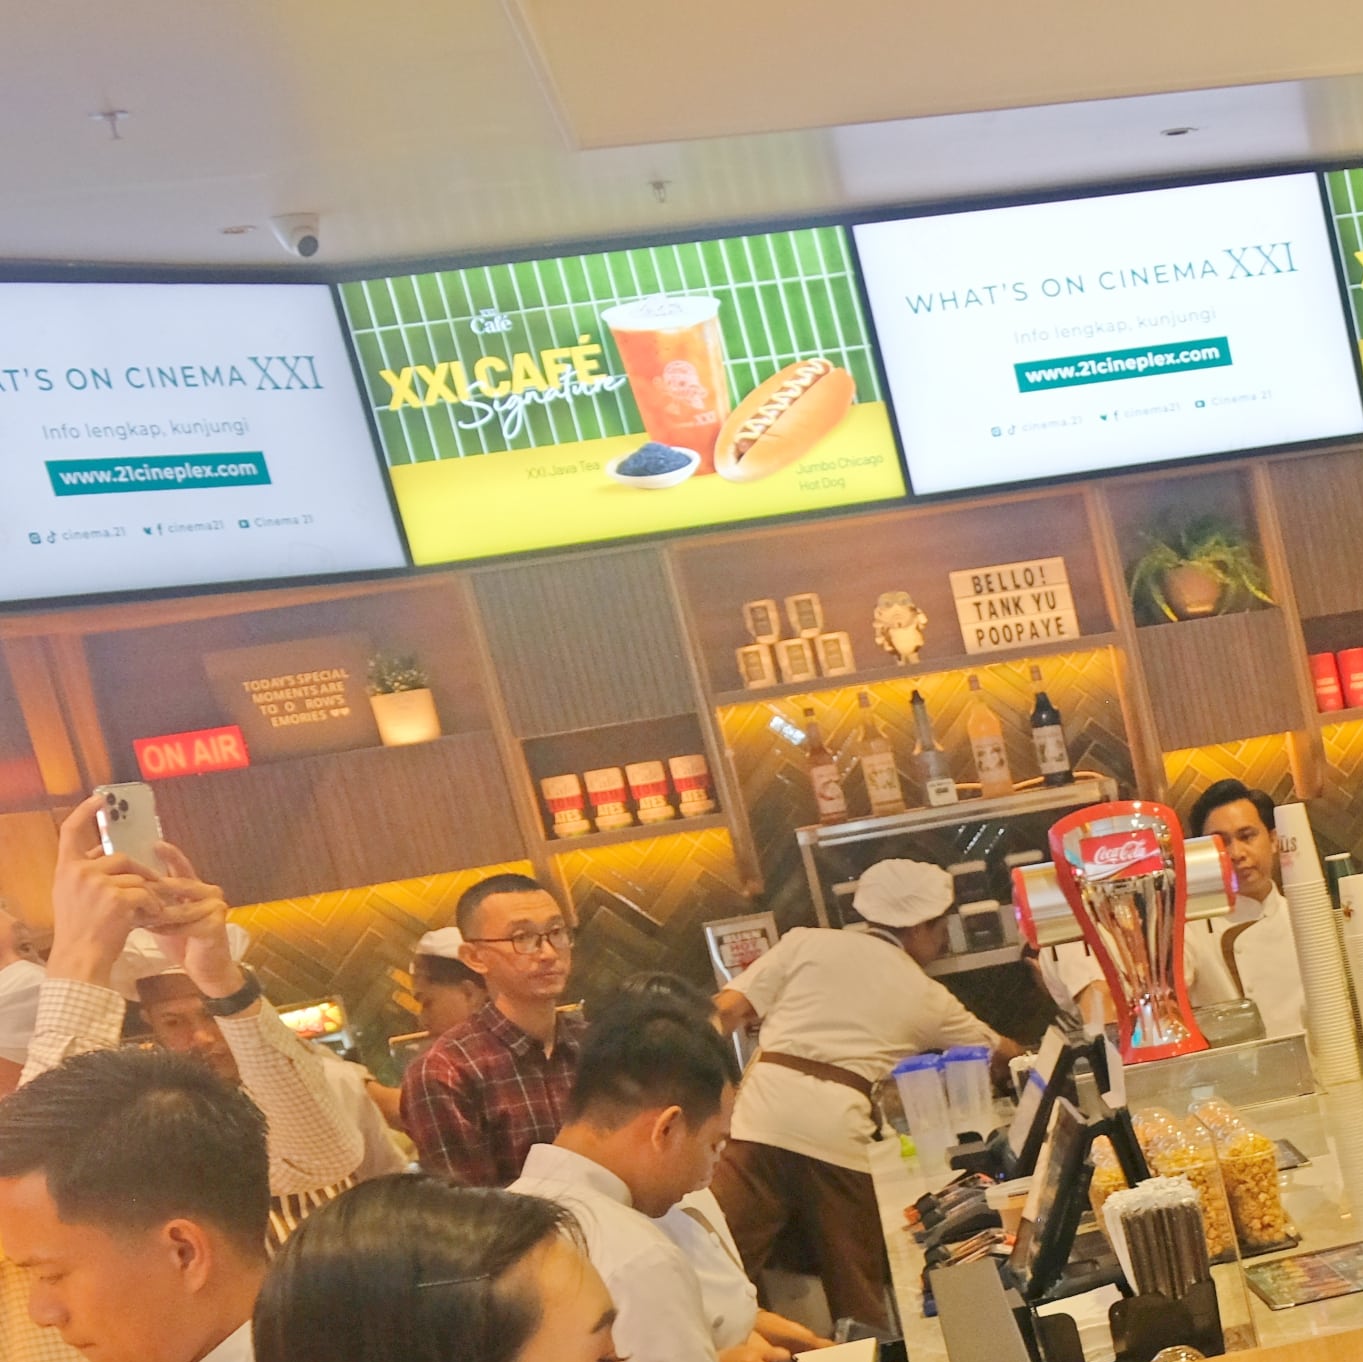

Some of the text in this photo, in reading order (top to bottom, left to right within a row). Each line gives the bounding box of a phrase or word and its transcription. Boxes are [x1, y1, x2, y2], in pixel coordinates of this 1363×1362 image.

[905, 241, 1300, 315] WHAT'S ON CINEMA XXI
[470, 314, 513, 335] Café
[1013, 327, 1051, 345] Info
[1137, 307, 1217, 333] kunjungi
[65, 367, 112, 391] ON
[125, 364, 247, 389] CINEMA
[248, 355, 324, 390] XXI
[379, 334, 607, 411] XXI CAFÉ
[1025, 344, 1220, 385] www.21cineplex.com
[458, 364, 626, 440] Signature
[42, 417, 249, 442] Info lengkap, kunjungi
[59, 462, 257, 486] www.21cineplex.com
[577, 460, 601, 473] Tea
[797, 454, 884, 475] Jumbo Chicago
[800, 477, 846, 491] Hot Dog
[255, 516, 299, 528] Cinema
[301, 514, 314, 525] 21
[971, 565, 1046, 595] BELLO!
[973, 591, 1058, 622] TANK YU
[975, 615, 1067, 648] POOPAYE
[243, 668, 349, 692] TODAY'S SPECIAL
[252, 681, 345, 704] MOMENTS ARE
[142, 733, 241, 773] ON AIR
[1094, 839, 1147, 865] Coca-Cola
